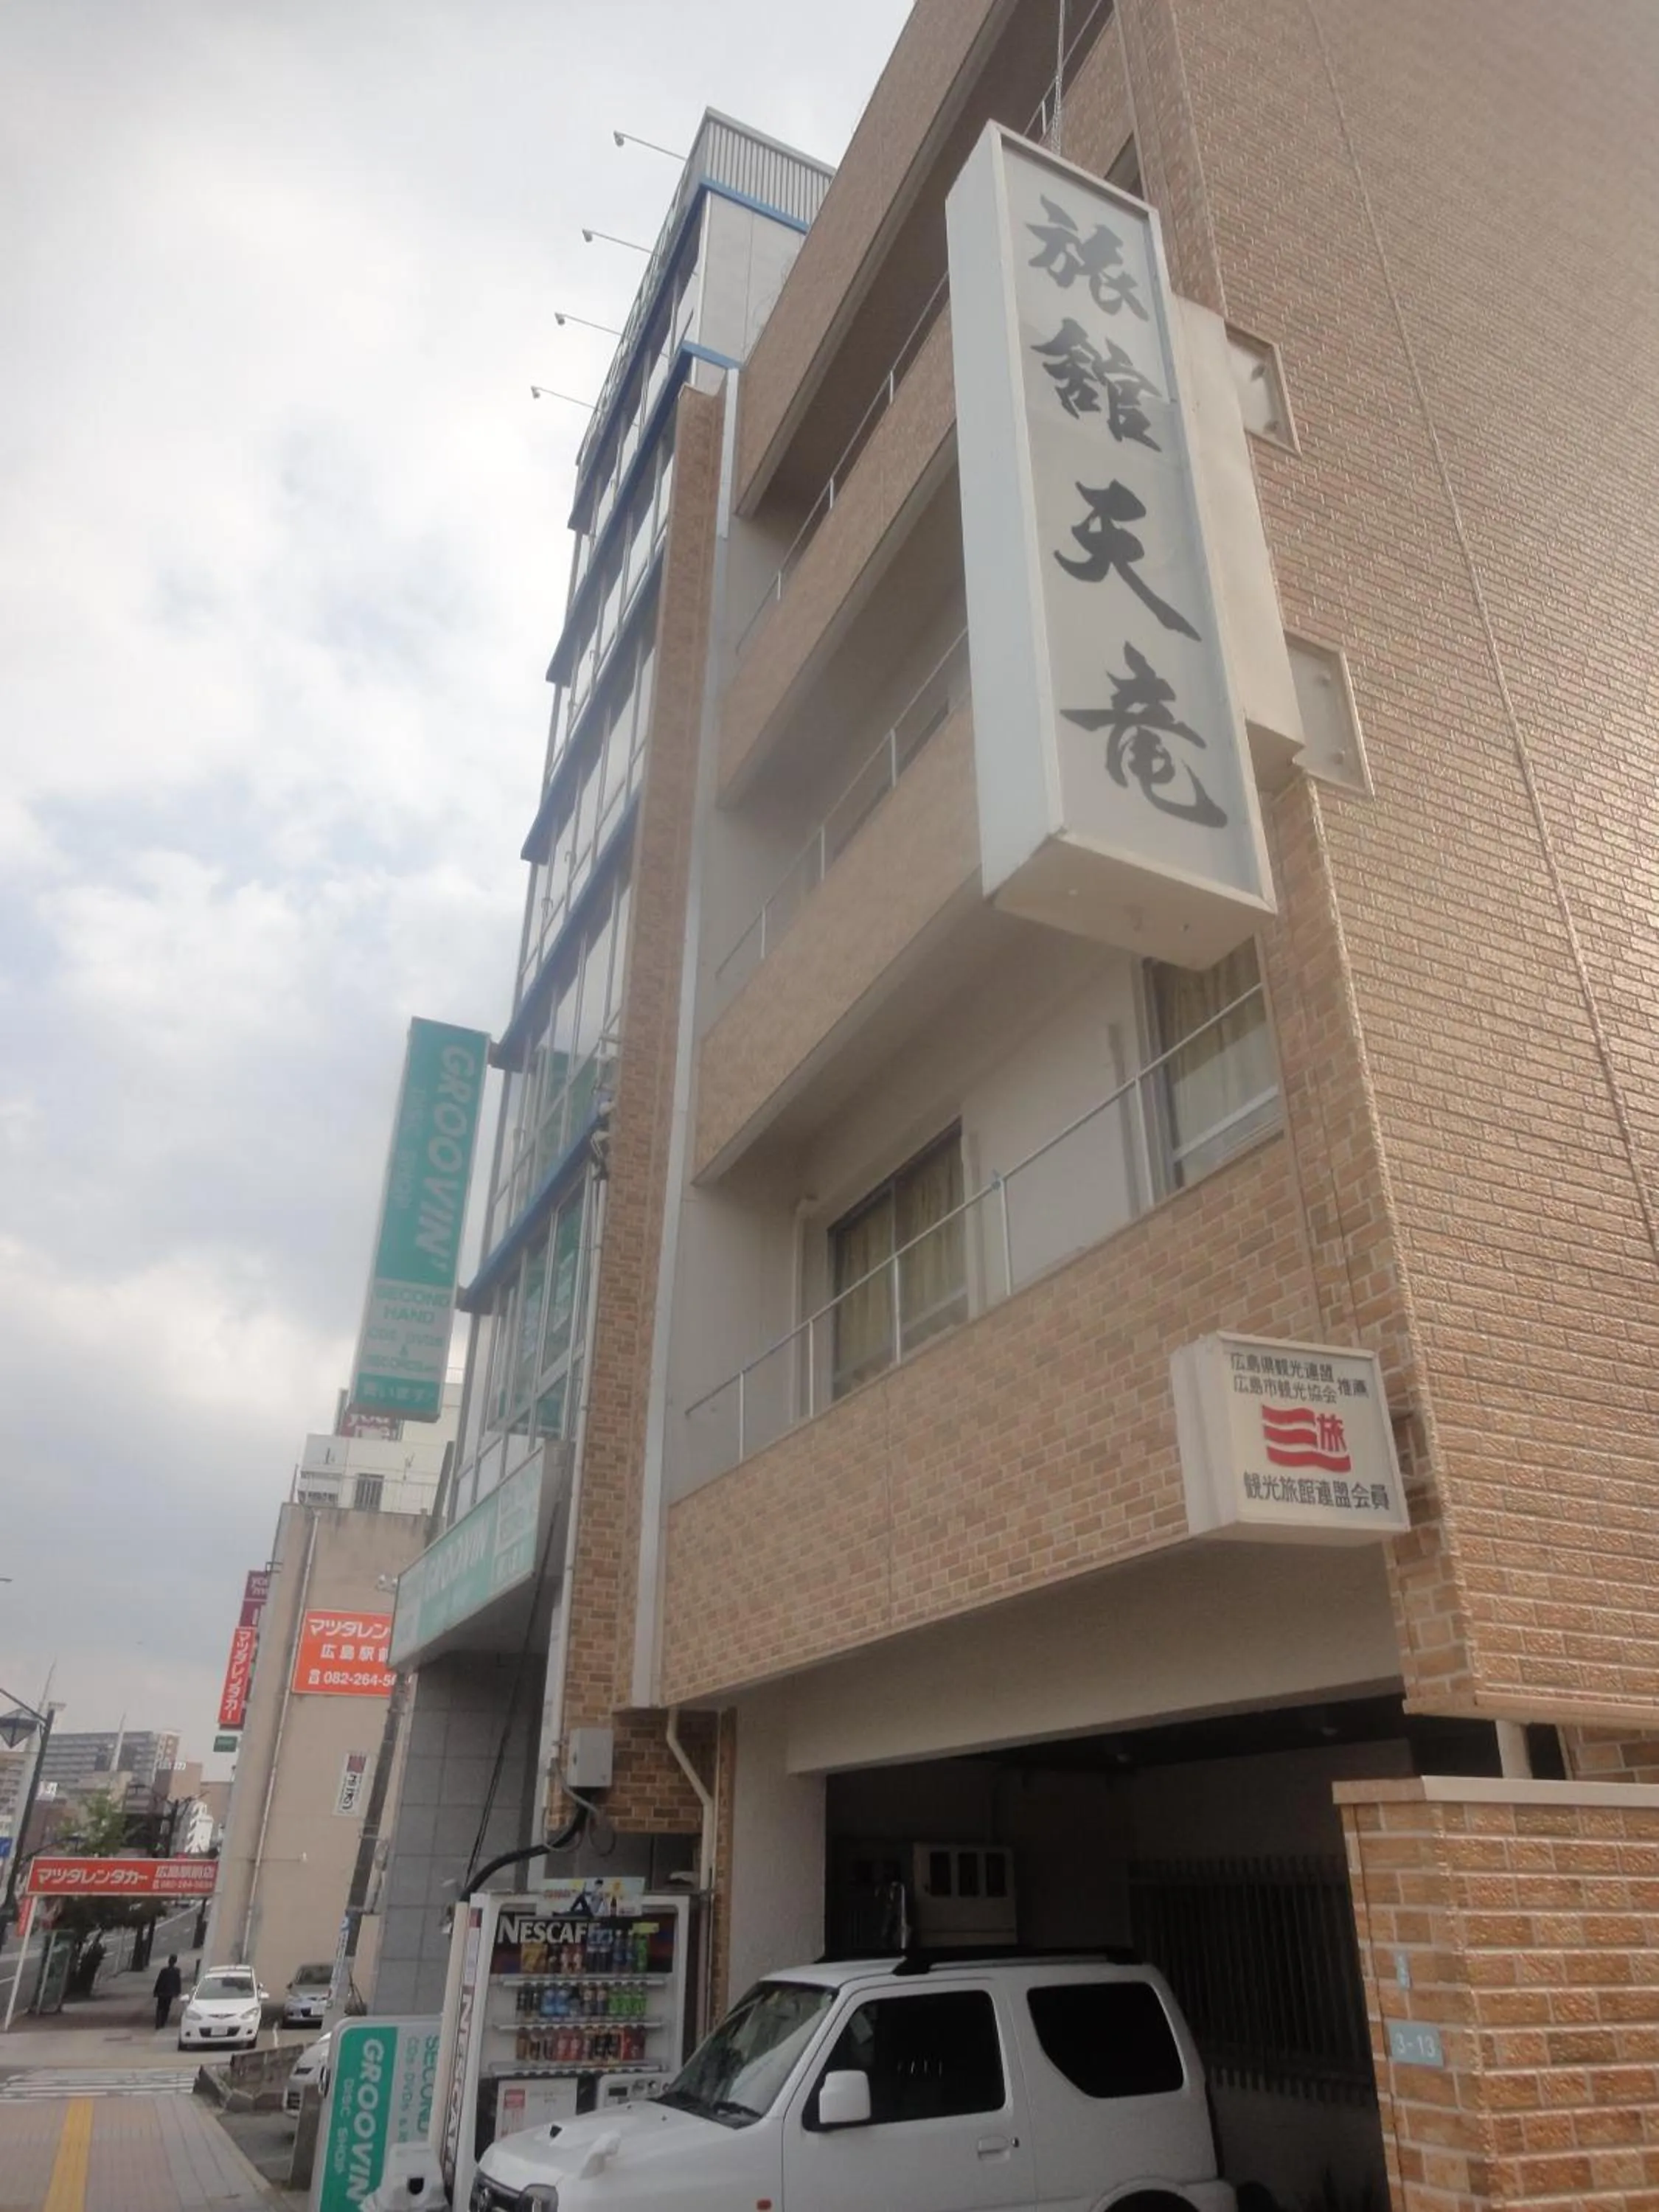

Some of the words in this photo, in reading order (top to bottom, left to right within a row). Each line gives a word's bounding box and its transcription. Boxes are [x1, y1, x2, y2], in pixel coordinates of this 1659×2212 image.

[374, 1286, 451, 1309] SECOND
[383, 1306, 436, 1324] HAND
[1230, 1352, 1335, 1383] 広島県観光連盟
[1233, 1374, 1337, 1404] 広島市観光協会
[1243, 1471, 1391, 1512] 観光旅館連盟会員
[223, 1630, 251, 1722] マツダレンタカー
[36, 1867, 149, 1886] マツダレンタカー
[1394, 2032, 1436, 2058] 3-13
[339, 2078, 355, 2118] DISC
[417, 2034, 441, 2135] SECOND
[333, 2126, 349, 2176] SHOP
